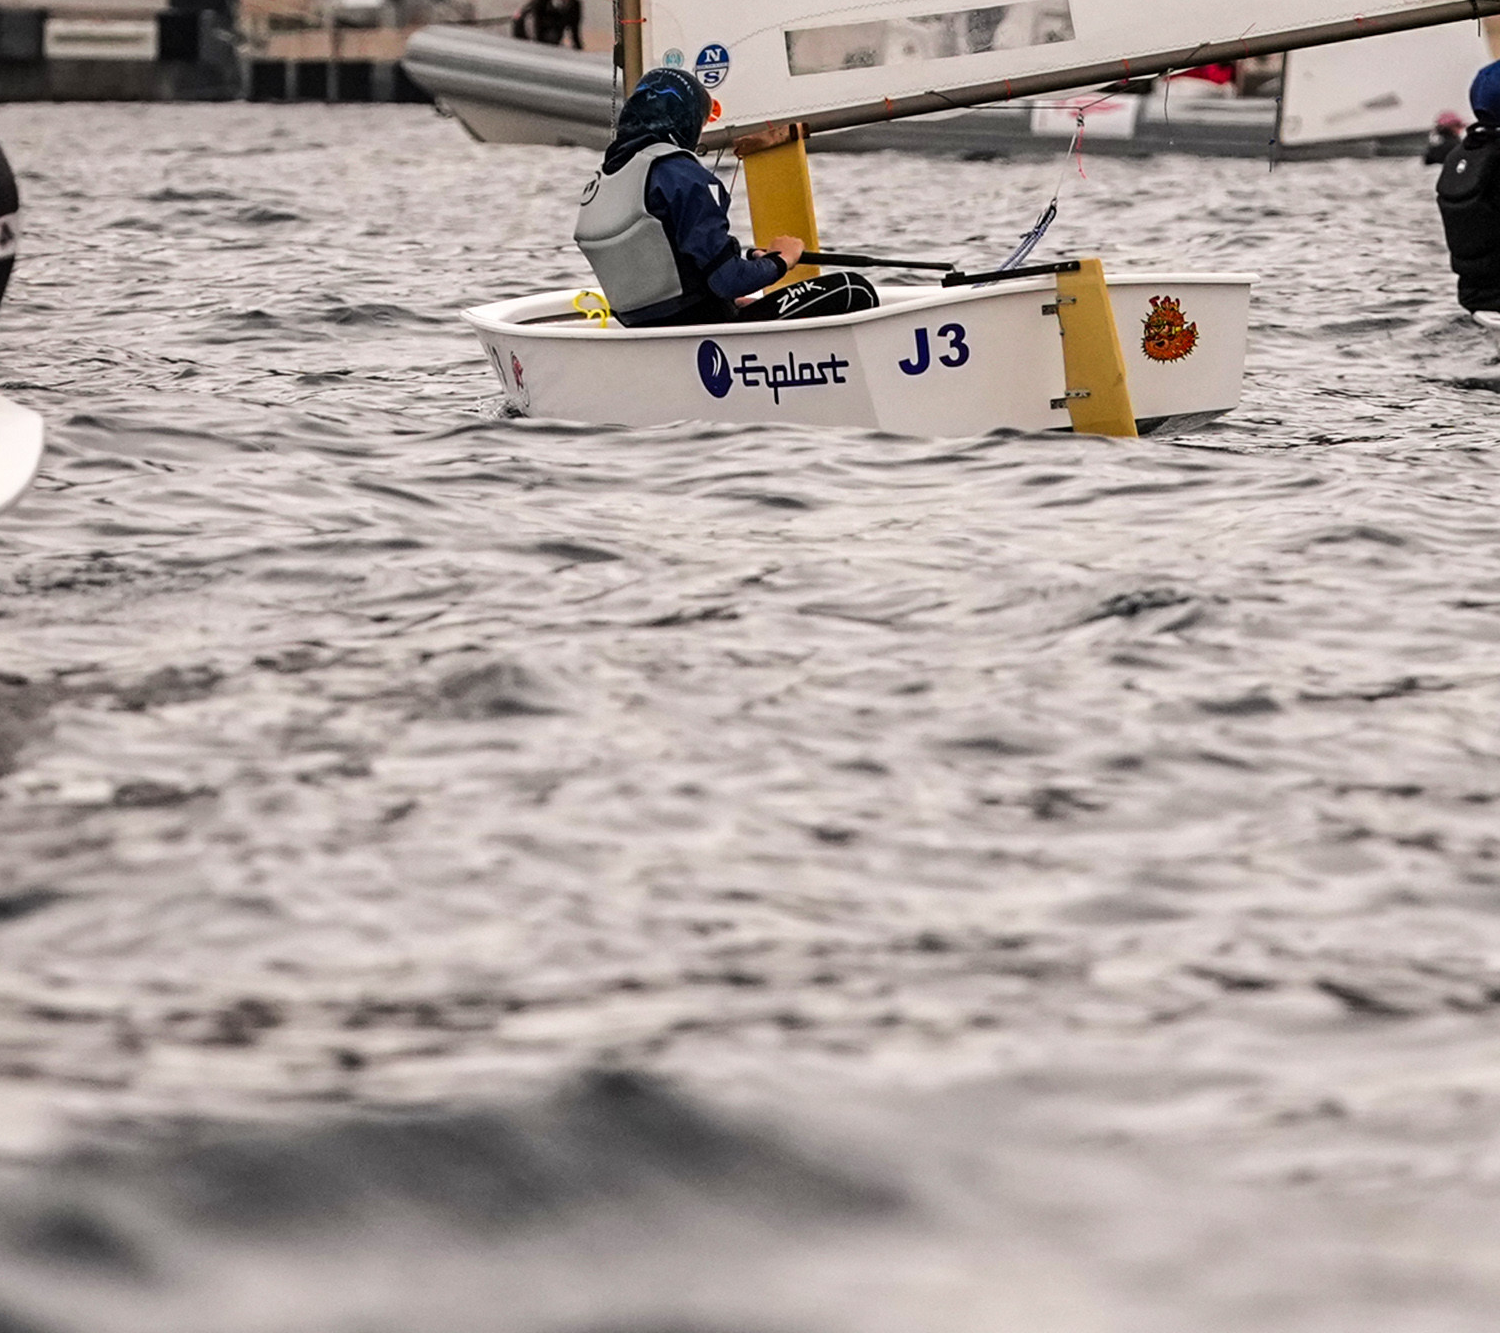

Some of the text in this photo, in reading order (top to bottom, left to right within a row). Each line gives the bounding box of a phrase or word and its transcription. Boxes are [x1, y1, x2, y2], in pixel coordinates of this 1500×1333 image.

[704, 48, 722, 63] N
[703, 71, 719, 84] S
[898, 323, 970, 376] J3
